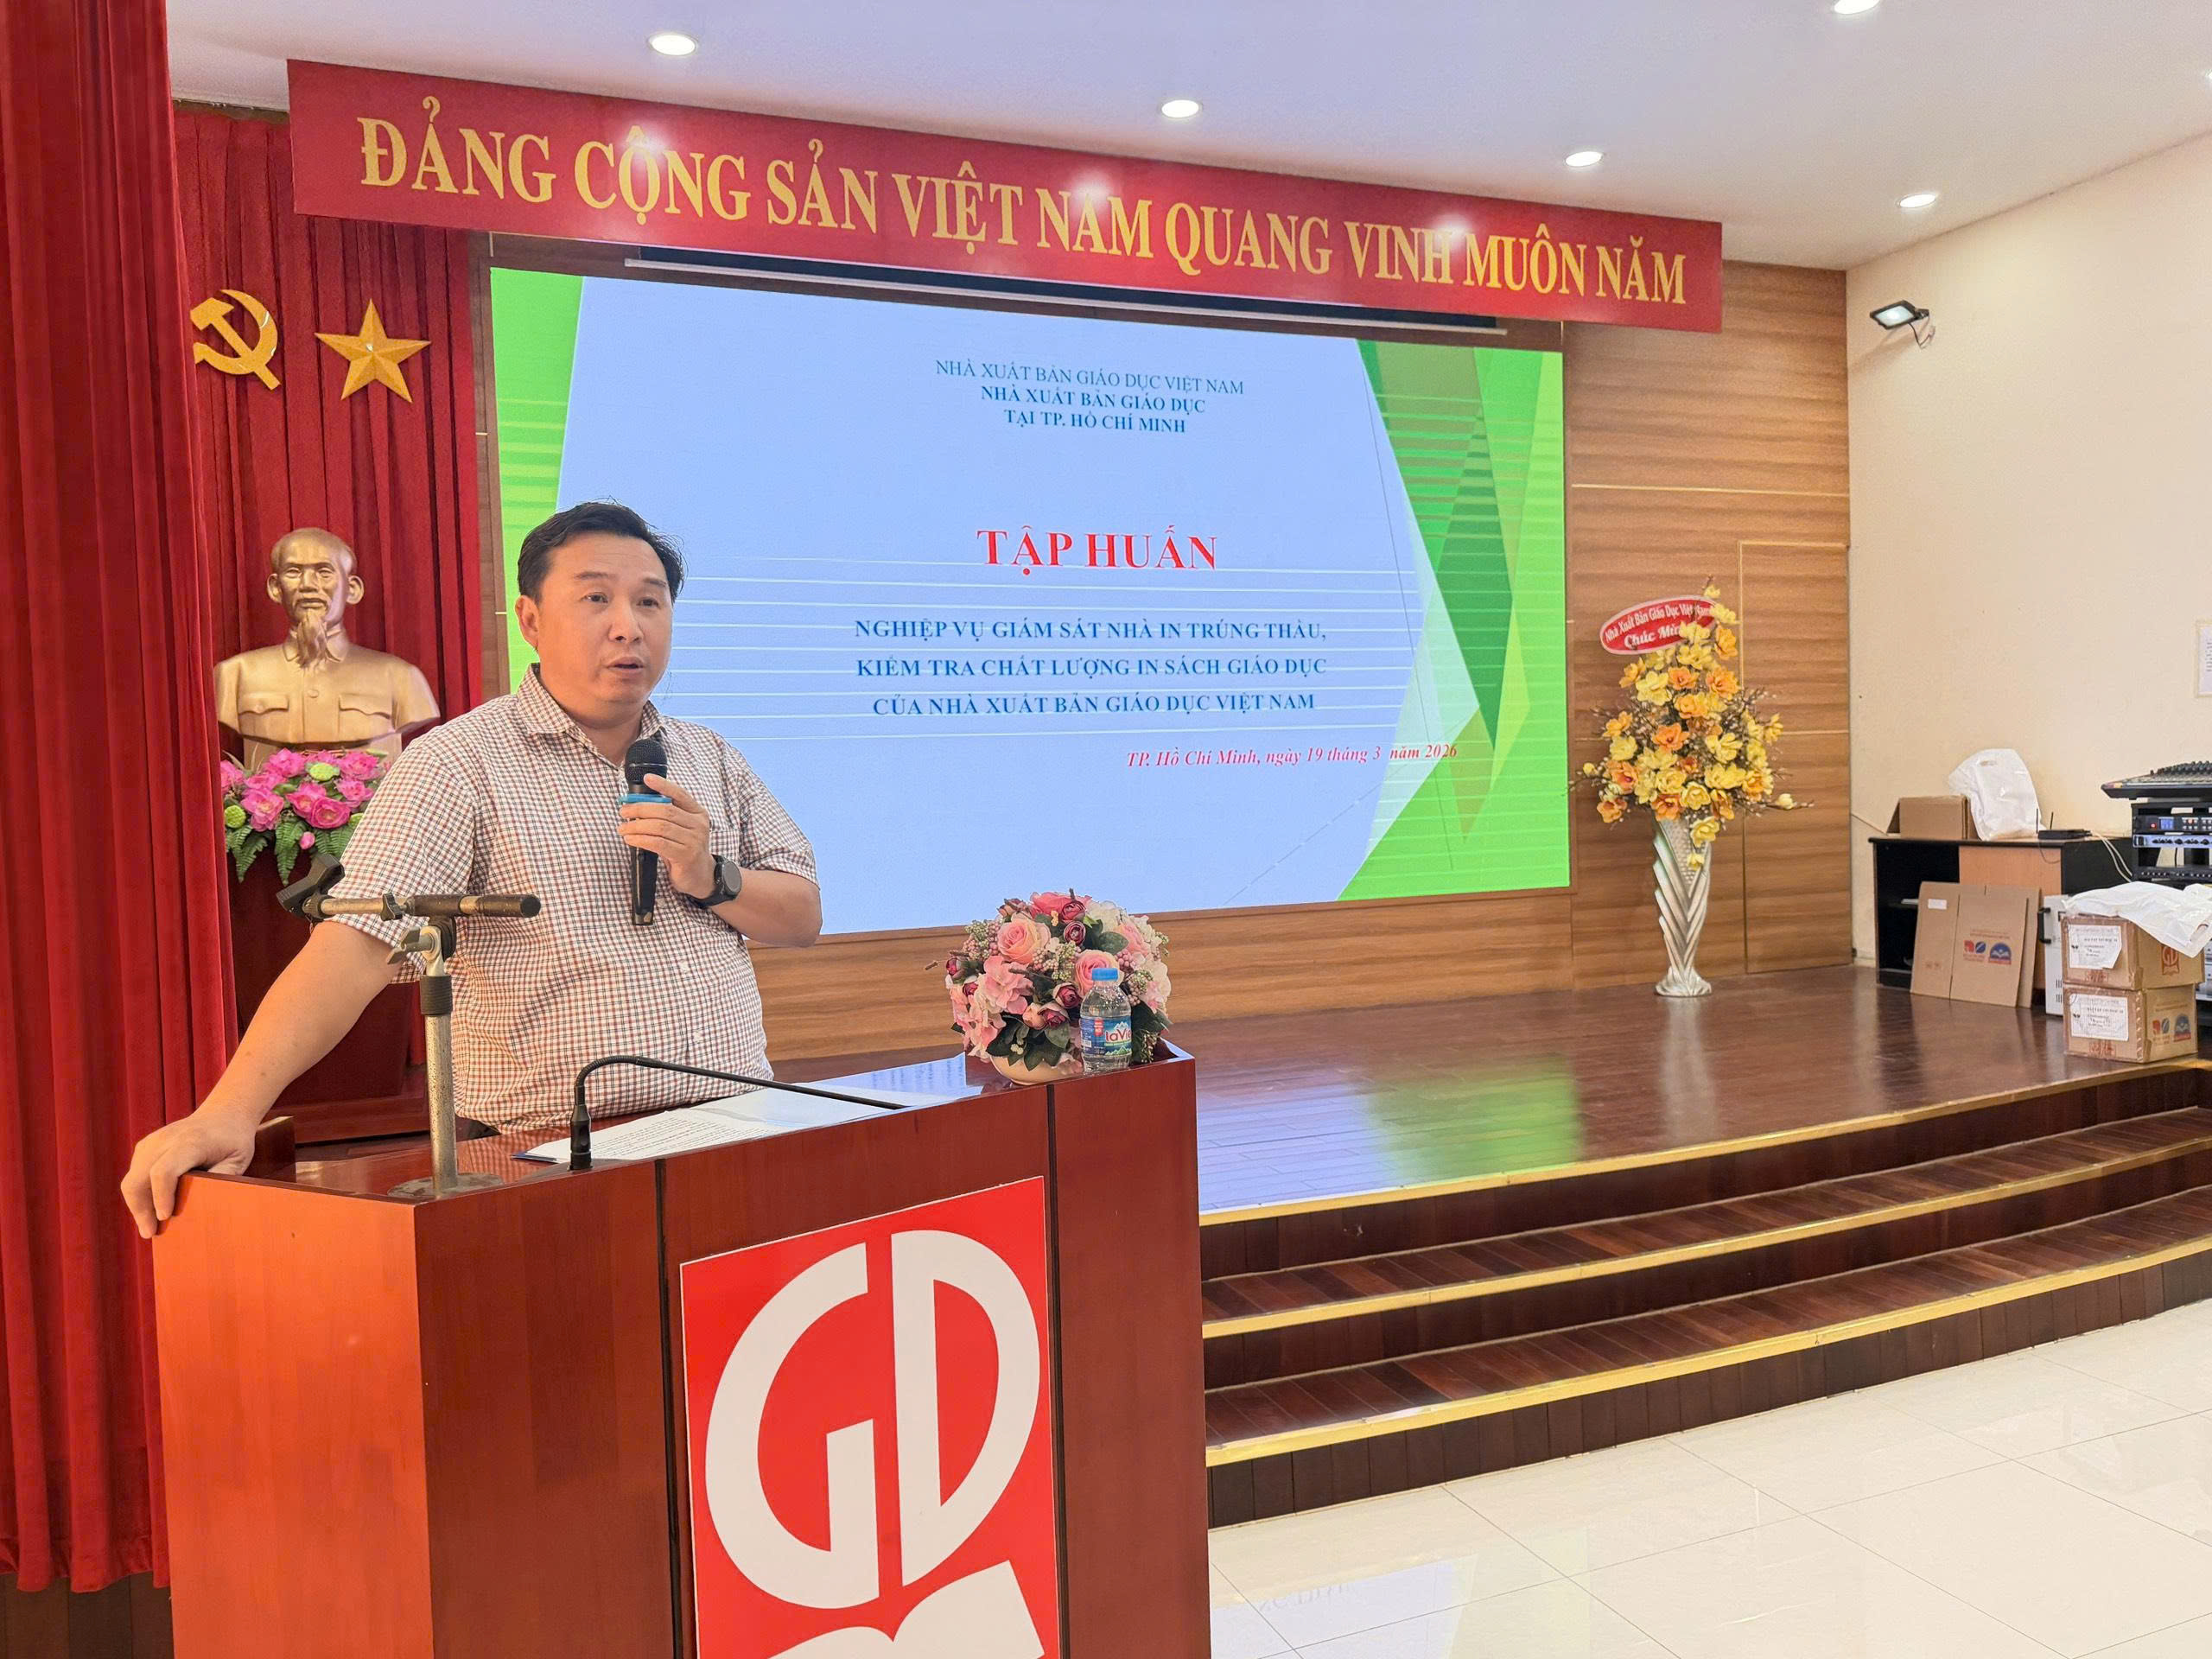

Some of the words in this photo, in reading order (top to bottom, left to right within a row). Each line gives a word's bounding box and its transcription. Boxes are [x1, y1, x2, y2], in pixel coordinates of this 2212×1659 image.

[357, 95, 556, 203] ĐẢNG
[574, 124, 751, 226] CỘNG
[766, 138, 878, 234] SẢN
[892, 160, 1023, 255] VIỆT
[1035, 187, 1154, 258] NAM
[1165, 201, 1332, 276] QUANG
[1344, 221, 1454, 285] VINH
[1463, 223, 1587, 297] MUÔN
[1595, 235, 1687, 305] NĂM
[936, 359, 976, 378] NHÀ
[982, 361, 1031, 382] XUẤT
[1036, 365, 1071, 385] BẢN
[1077, 368, 1120, 387] GIÁO
[1125, 373, 1160, 391] DỤC
[1165, 375, 1202, 394] VIỆT
[1205, 378, 1244, 395] NAM
[981, 384, 1021, 402] NHÀ
[1026, 386, 1075, 405] XUẤT
[1081, 389, 1116, 409] BẢN
[1121, 392, 1166, 411] GIÁO
[1171, 398, 1205, 416] DỤC
[1004, 410, 1034, 428] TẠI
[1040, 411, 1065, 426] TP.
[1071, 410, 1097, 429] HỒ
[1102, 412, 1133, 430] CHÍ
[1139, 417, 1185, 433] MINH
[976, 524, 1073, 575] TẬP
[1084, 524, 1217, 570] HUẤN
[855, 618, 947, 641] NGHIỆP
[952, 620, 984, 641] VỤ
[992, 617, 1052, 638] GIÁM
[1059, 617, 1101, 639] SÁT
[1107, 618, 1152, 639] NHÀ
[1160, 623, 1182, 639] IN
[1187, 619, 1259, 639] TRÚNG
[1263, 619, 1327, 641] THẦU,
[857, 653, 921, 677] KIỂM
[928, 659, 976, 677] TRA
[982, 654, 1047, 677] CHẤT
[1052, 657, 1129, 679] LƯỢNG
[1137, 659, 1159, 675] IN
[1165, 655, 1220, 675] SÁCH
[1228, 655, 1279, 675] GIÁO
[1285, 658, 1327, 677] DỤC
[873, 694, 925, 715] CỦA
[929, 694, 979, 715] NHÀ
[986, 693, 1049, 715] XUẤT
[1054, 692, 1099, 714] BẢN
[1105, 691, 1160, 712] GIÁO
[1166, 695, 1211, 715] DỤC
[1216, 692, 1264, 715] VIỆT
[1269, 694, 1315, 710] NAM
[1127, 751, 1151, 767] TP.
[1156, 747, 1180, 766] Hồ
[1183, 749, 1211, 766] Chí
[1216, 749, 1262, 766] Minh,
[1265, 747, 1301, 766] ngày
[1306, 746, 1324, 762] 19
[1326, 746, 1368, 763] tháng
[1372, 746, 1382, 760] 3
[1389, 747, 1421, 760] năm
[1424, 743, 1459, 759] 2026
[705, 1229, 1041, 1610] GD
